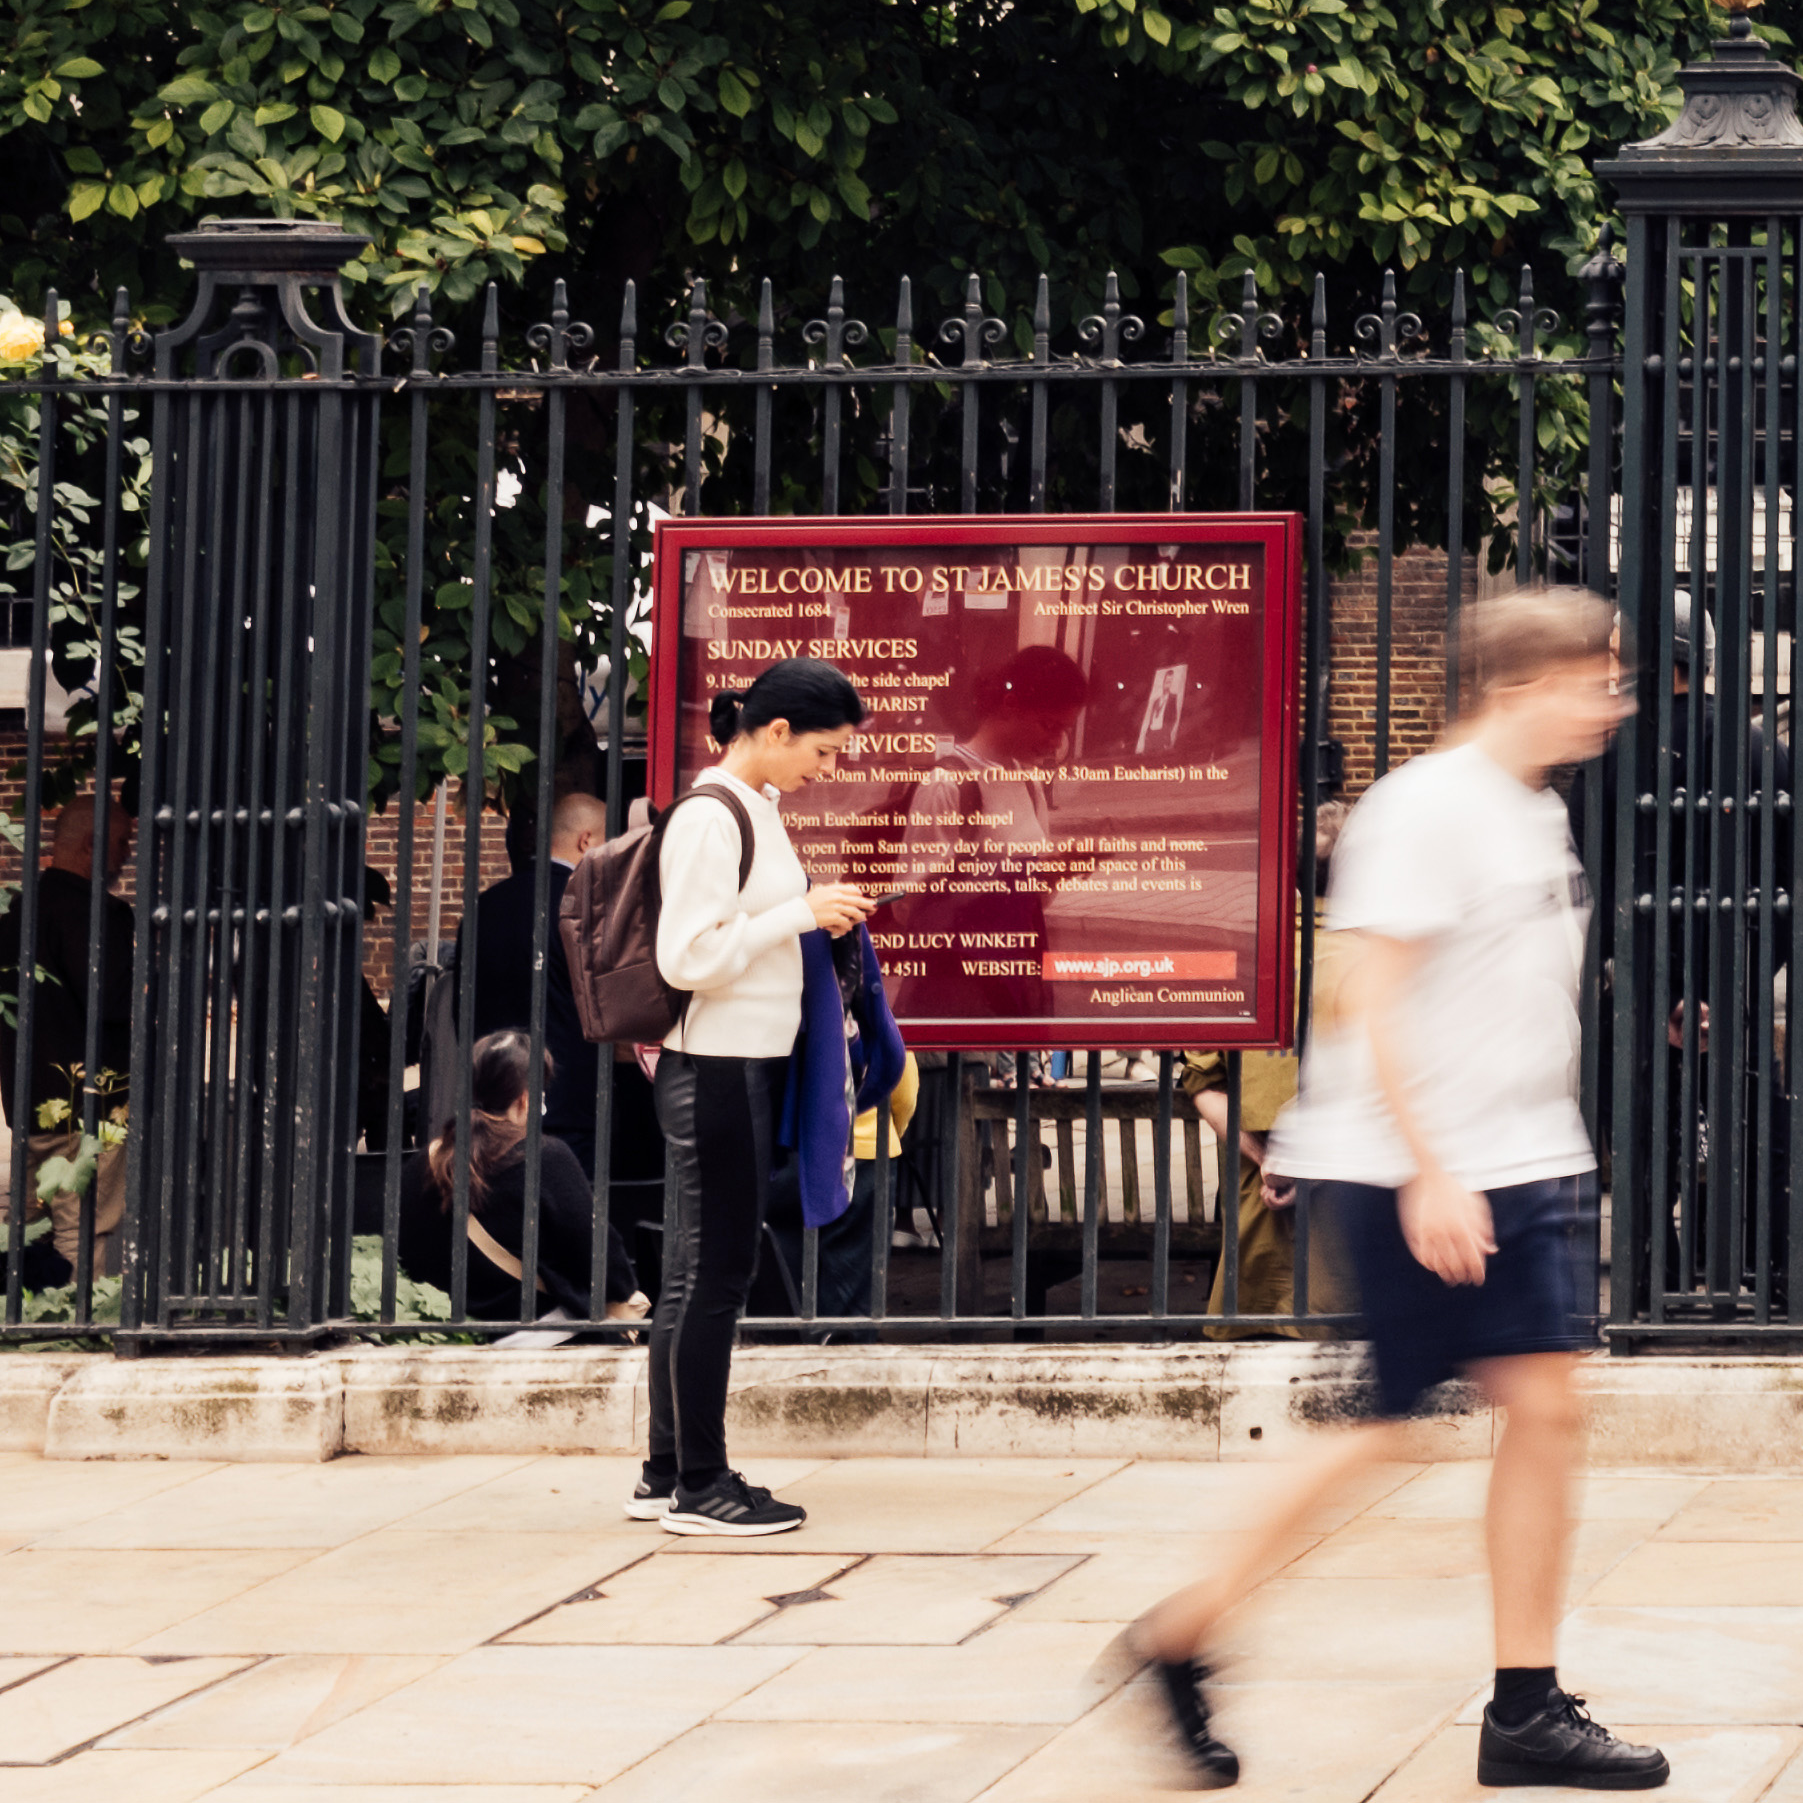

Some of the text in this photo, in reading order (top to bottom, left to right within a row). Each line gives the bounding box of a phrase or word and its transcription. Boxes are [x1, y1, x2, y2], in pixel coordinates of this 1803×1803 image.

[710, 563, 1251, 594] WELCOME TO ST JAMES'S CHURCH
[708, 603, 831, 618] Consecrated 1684
[1034, 599, 1250, 618] Architect Sir Christopher Wren
[707, 638, 918, 660] SUNDAY SERVICES
[872, 672, 901, 688] side
[904, 672, 950, 691] chapel
[841, 733, 937, 755] ERVICES
[870, 767, 931, 786] Morning
[935, 767, 981, 785] Prayer
[983, 765, 1055, 785] (Thursday
[1058, 765, 1111, 781] 8.30am
[1114, 764, 1186, 784] Eucharist)
[1189, 764, 1204, 780] in
[1206, 764, 1229, 781] the
[824, 811, 889, 827] Eucharist
[893, 811, 907, 826] in
[911, 811, 934, 827] the
[936, 810, 965, 826] side
[967, 810, 1014, 829] chapel
[802, 843, 837, 858] open
[840, 839, 875, 855] from
[878, 840, 908, 855] 8am
[911, 842, 951, 859] every
[954, 839, 980, 858] day
[983, 838, 1005, 854] for
[1007, 838, 1054, 857] people
[1057, 837, 1075, 853] of
[1076, 837, 1094, 852] all
[1098, 837, 1136, 853] faiths
[1140, 837, 1166, 852] and
[1169, 839, 1209, 852] none.
[852, 860, 867, 874] to
[869, 862, 908, 874] come
[912, 859, 926, 874] in
[929, 859, 955, 874] and
[958, 859, 998, 878] enjoy
[1001, 858, 1024, 874] the
[1026, 861, 1067, 877] peace
[1070, 858, 1096, 873] and
[1098, 860, 1138, 876] space
[1141, 857, 1160, 873] of
[1160, 857, 1186, 872] this
[930, 878, 948, 894] of
[949, 879, 1011, 895] concerts,
[1015, 877, 1052, 894] talks,
[1056, 877, 1109, 893] debates
[1112, 877, 1138, 893] and
[1141, 879, 1185, 893] events
[1189, 877, 1203, 893] is
[908, 932, 956, 950] LUCY
[960, 932, 1039, 949] WINKETT
[893, 961, 927, 977] 4511
[962, 960, 1042, 977] WEBSITE:
[1054, 956, 1175, 979] www.sjp.org.uk
[1090, 987, 1246, 1007] Anglican Communion
